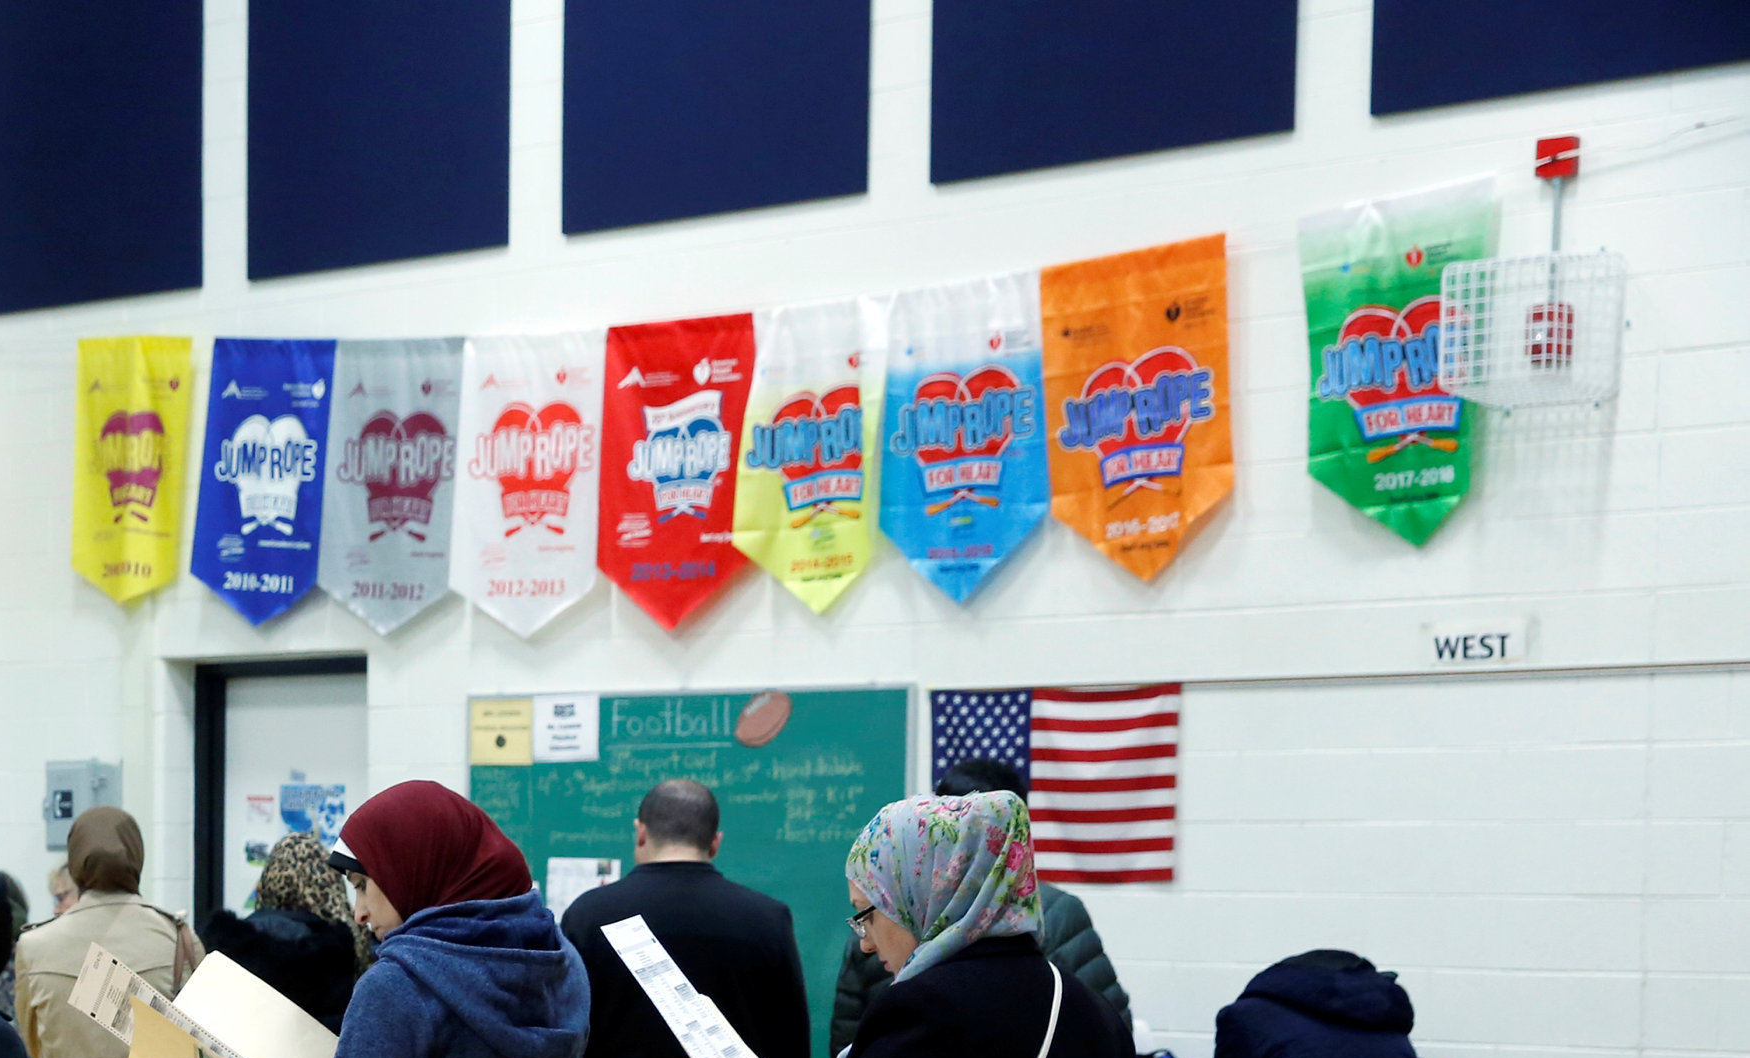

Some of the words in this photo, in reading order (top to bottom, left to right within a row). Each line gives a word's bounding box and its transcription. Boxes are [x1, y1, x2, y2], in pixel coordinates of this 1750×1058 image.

[1318, 336, 1402, 398] JUMP
[1133, 371, 1212, 436] ROPE
[1364, 408, 1401, 434] FOR
[746, 420, 818, 469] JUMP
[1434, 633, 1510, 660] WEST
[611, 697, 732, 738] Football
